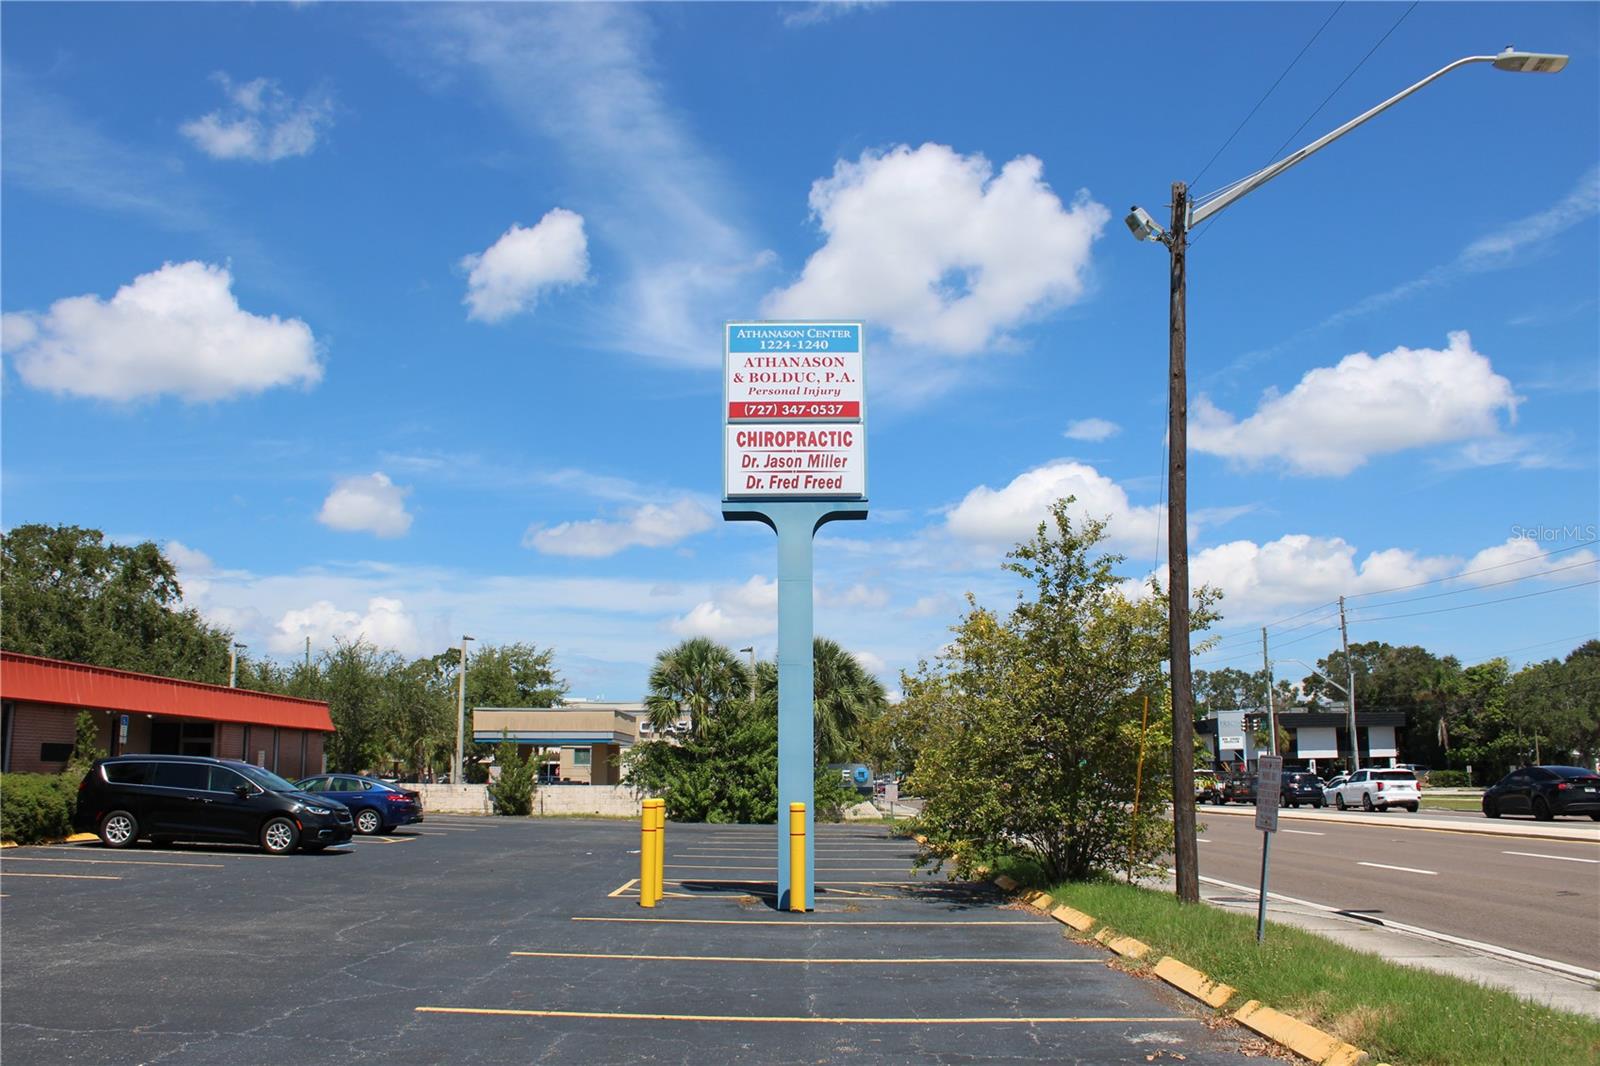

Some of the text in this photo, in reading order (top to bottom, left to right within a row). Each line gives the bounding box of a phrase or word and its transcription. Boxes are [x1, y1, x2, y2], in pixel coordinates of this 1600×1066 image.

[737, 329, 851, 338] ATHANASON CENTER
[760, 341, 829, 349] 1224-1240
[744, 357, 845, 367] ATHANASON
[733, 373, 855, 384] & BOLDUC, P.A.
[748, 387, 841, 397] Personal Injury
[745, 404, 843, 416] (727) 347-0537
[736, 431, 852, 447] CHIROPRACTIC
[742, 454, 847, 468] Dr. Jason Miller
[746, 475, 843, 489] Dr. Fred Freed
